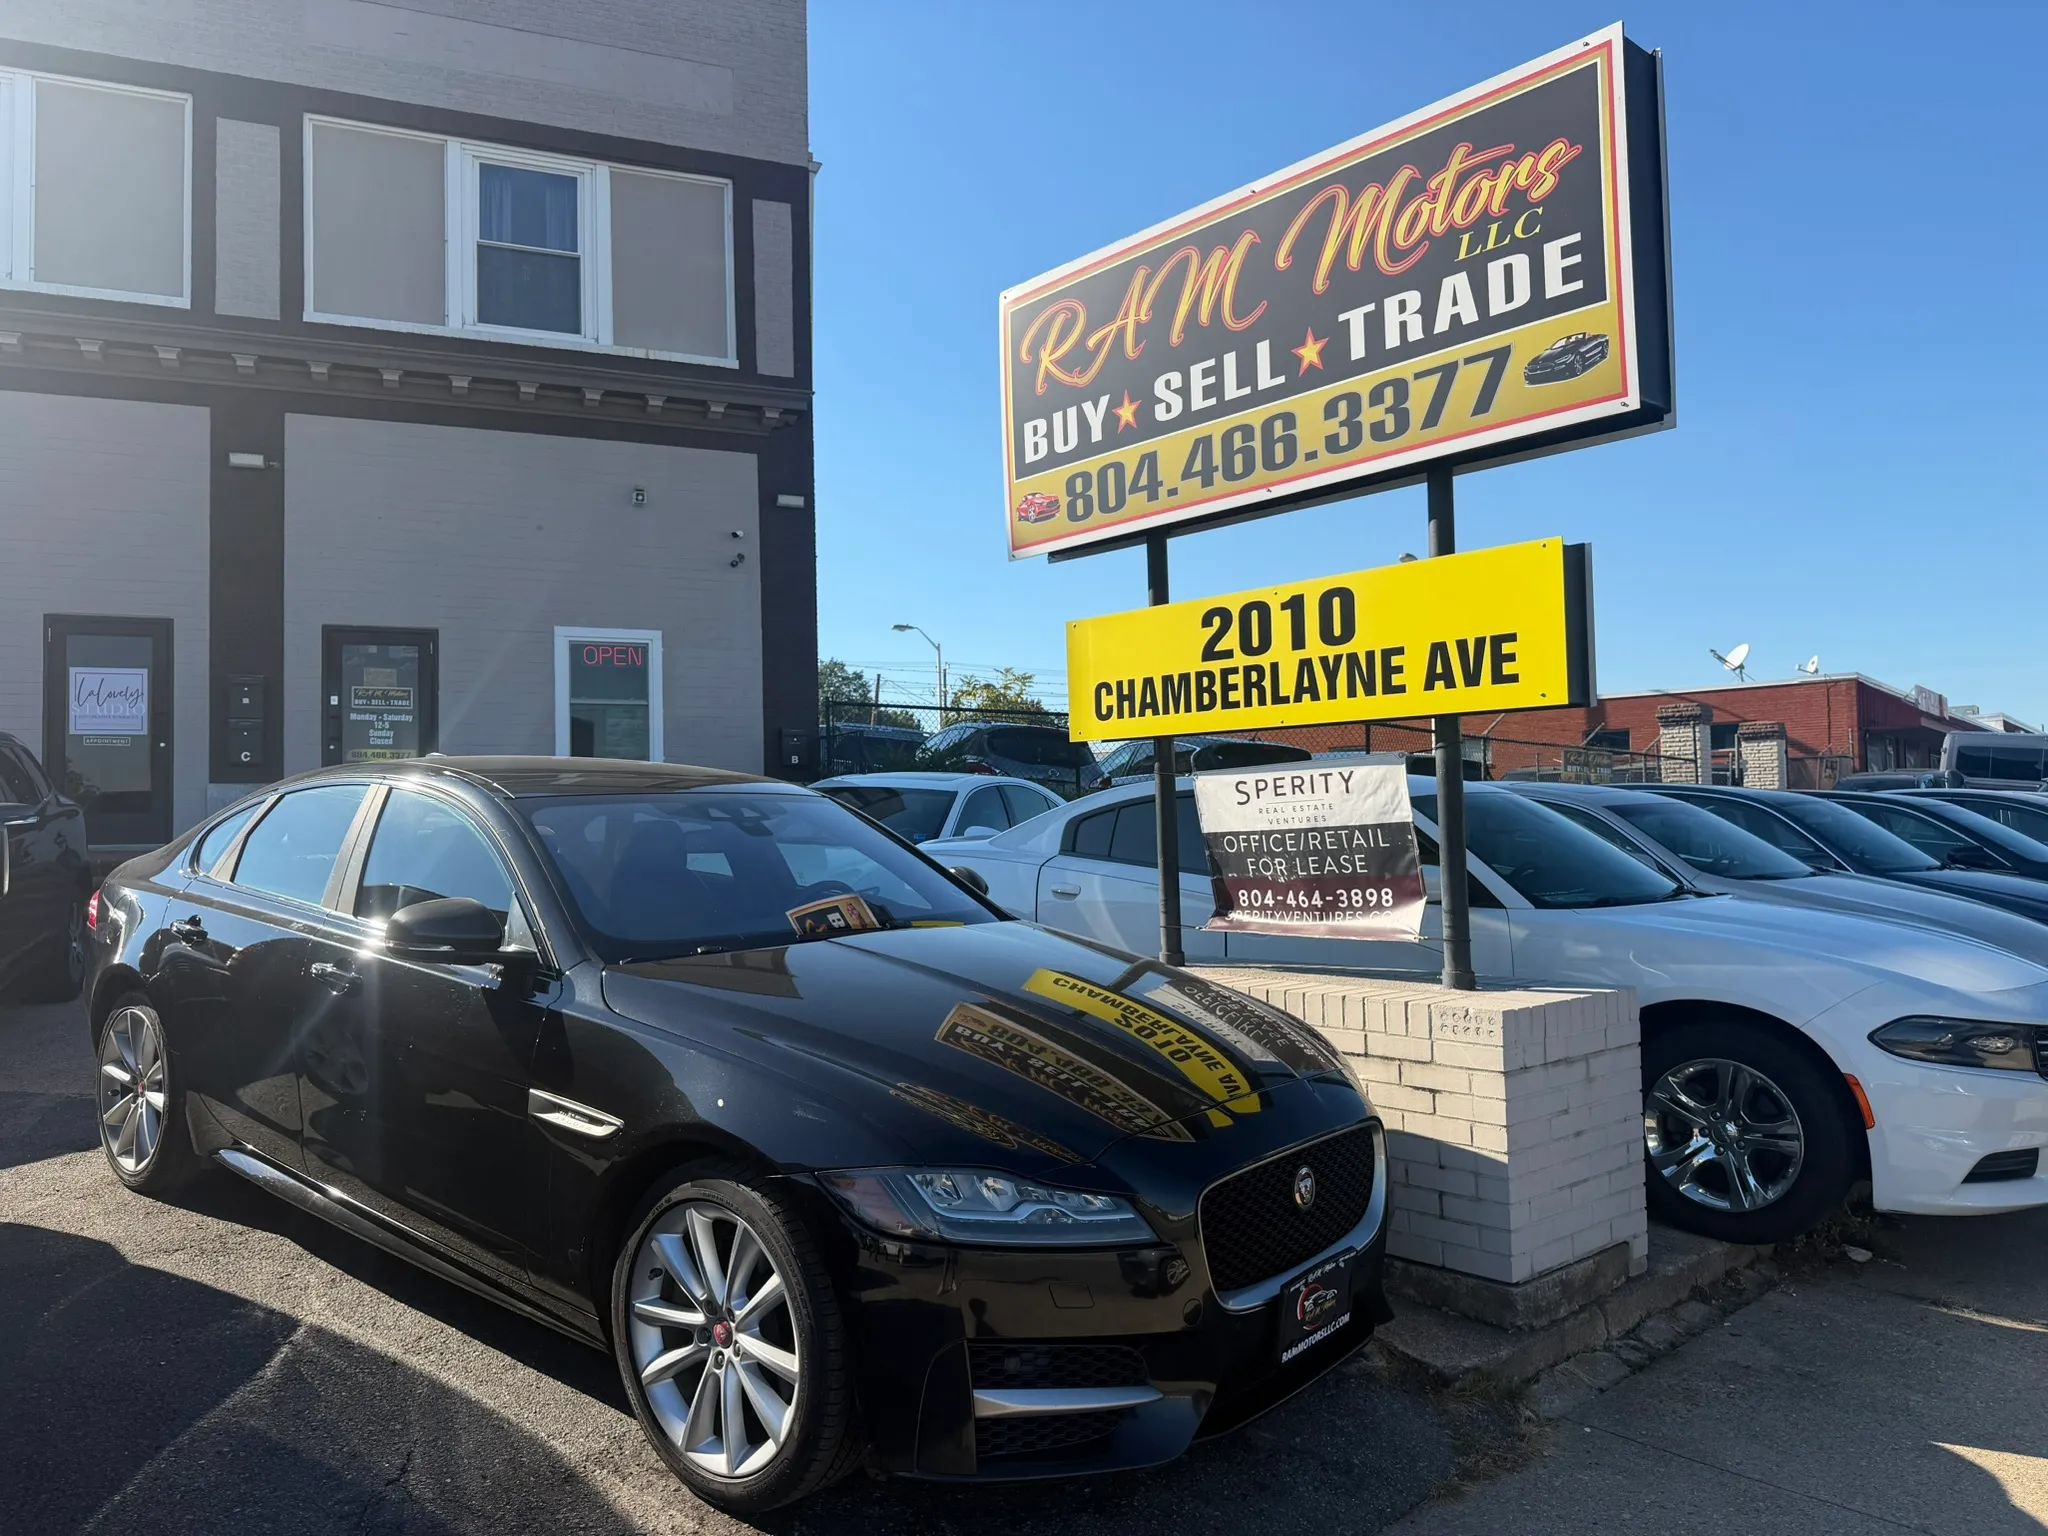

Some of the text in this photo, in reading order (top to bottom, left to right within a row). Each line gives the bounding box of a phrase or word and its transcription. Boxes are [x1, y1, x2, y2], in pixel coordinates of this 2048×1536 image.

[1454, 206, 1543, 262] LLC
[1020, 137, 1582, 396] RAM Motors
[1024, 232, 1583, 463] BUY SELL TRADE
[1065, 342, 1515, 524] 804.466.3377
[1201, 586, 1356, 662] 2010
[583, 645, 642, 666] OPEN
[1095, 632, 1519, 722] CHAMBERLAYNE AVE
[350, 712, 377, 721] Monday
[383, 713, 413, 722] Saturday
[369, 729, 394, 738] Sunday
[369, 737, 393, 745] Closed
[241, 751, 251, 762] C
[791, 755, 799, 764] B
[1235, 770, 1355, 806] SPERITY
[1258, 803, 1334, 815] REAL ESTATE
[1267, 815, 1327, 825] VENTURES
[1223, 828, 1391, 853] OFFICE/RETAIL
[1247, 854, 1369, 876] FOR LEASE
[1238, 887, 1394, 908] 804-464-3898
